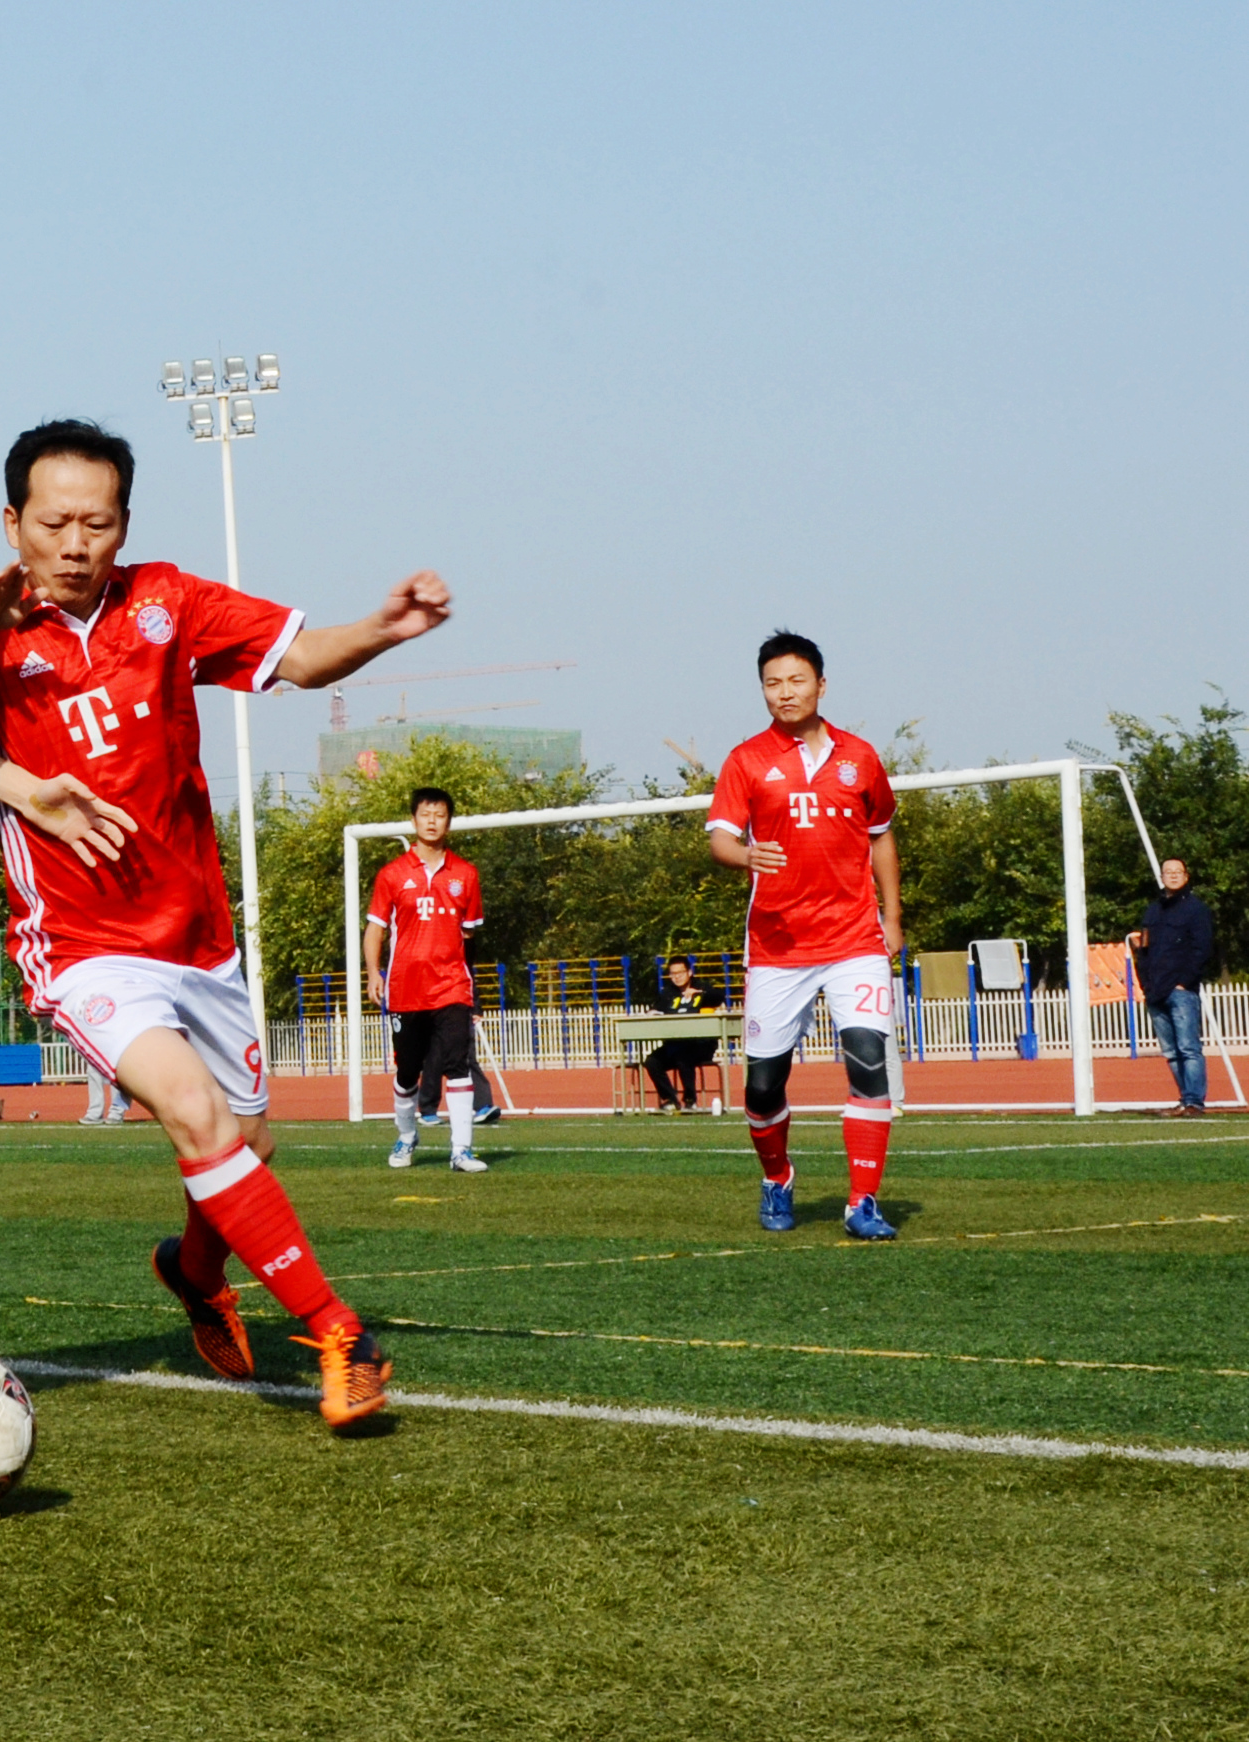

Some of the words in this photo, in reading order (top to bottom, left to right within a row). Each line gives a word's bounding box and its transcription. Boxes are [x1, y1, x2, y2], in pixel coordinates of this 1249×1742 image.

[19, 662, 55, 678] adidas
[854, 983, 891, 1016] 20
[244, 1040, 262, 1094] 9
[853, 1158, 877, 1168] FCB
[262, 1245, 302, 1277] FCB
